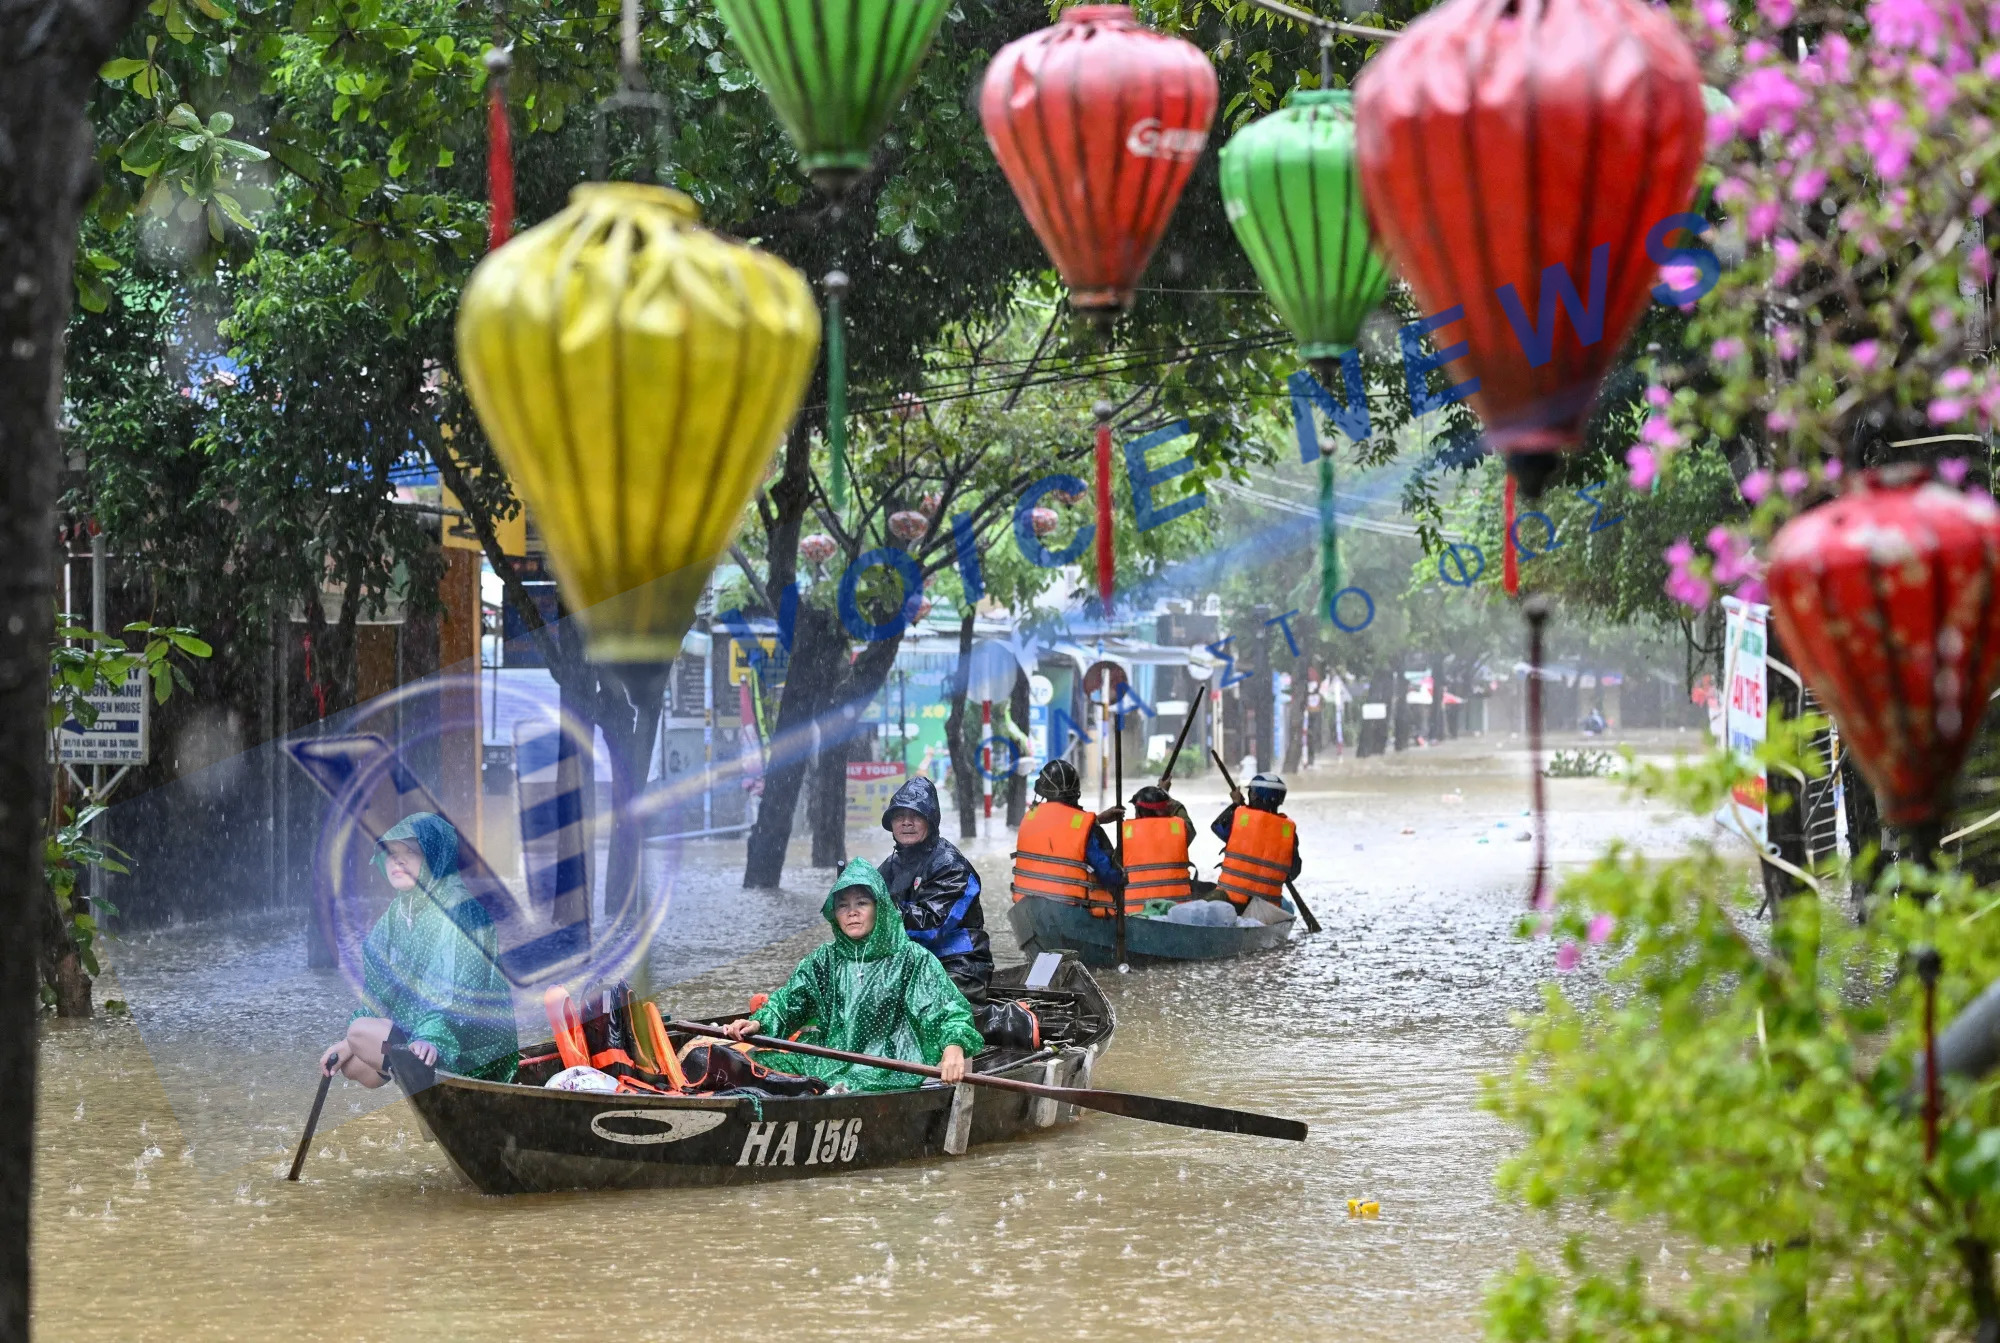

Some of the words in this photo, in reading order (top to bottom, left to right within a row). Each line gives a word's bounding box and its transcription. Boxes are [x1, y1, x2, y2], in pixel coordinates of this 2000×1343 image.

[114, 701, 141, 713] HOUSE
[85, 721, 117, 731] 0M
[866, 765, 898, 775] TOUR
[736, 1121, 798, 1166] HA
[804, 1117, 863, 1166] 156
